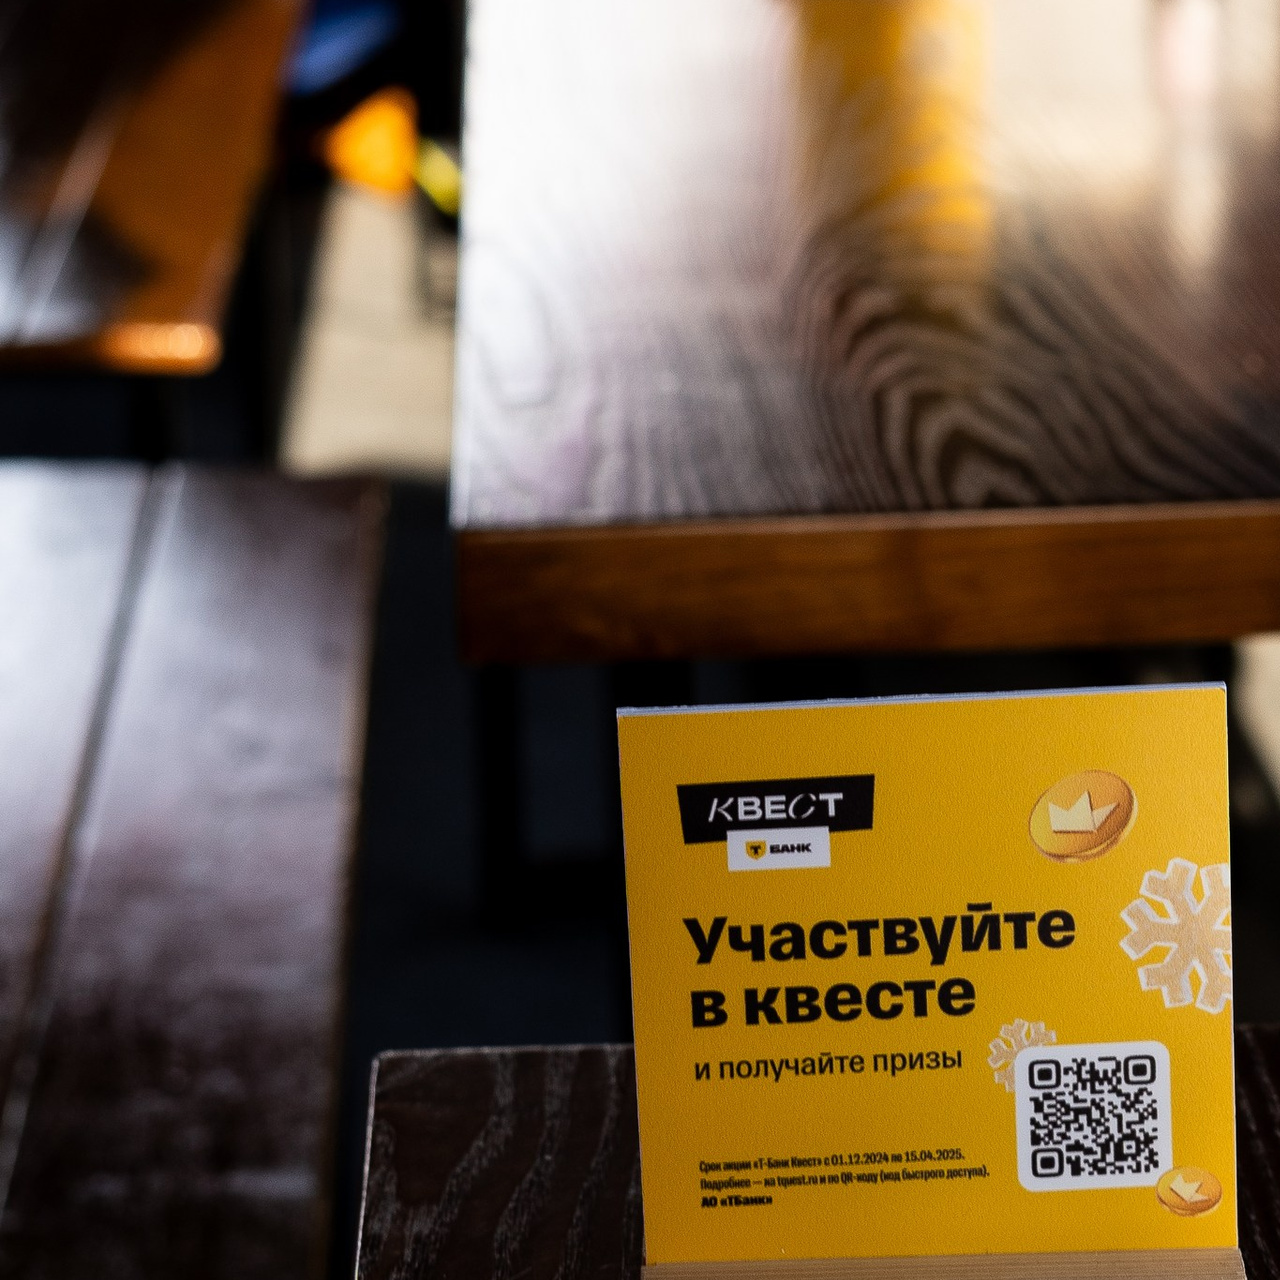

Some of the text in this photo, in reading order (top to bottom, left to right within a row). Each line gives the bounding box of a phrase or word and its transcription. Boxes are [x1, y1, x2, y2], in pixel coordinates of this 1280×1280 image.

[708, 792, 843, 823] КВЕСТ
[769, 842, 812, 855] БАНК
[683, 902, 1076, 965] Участвуйте
[690, 976, 976, 1029] в квесте
[695, 1049, 963, 1082] и получайте призы
[699, 1148, 965, 1173] Срок акции «Т-Банк Квест» с 01.12.2024 по 15.04.2025.
[700, 1177, 751, 1191] Подробнее
[764, 1177, 776, 1187] на
[777, 1174, 818, 1188] tquest.ru
[819, 1175, 826, 1184] и
[828, 1173, 839, 1183] по
[841, 1171, 878, 1185] QR-коду
[880, 1169, 900, 1183] (код
[902, 1167, 945, 1181] быстрого
[946, 1164, 990, 1180] доступа).
[701, 1195, 773, 1207] АО «ТБанк»
